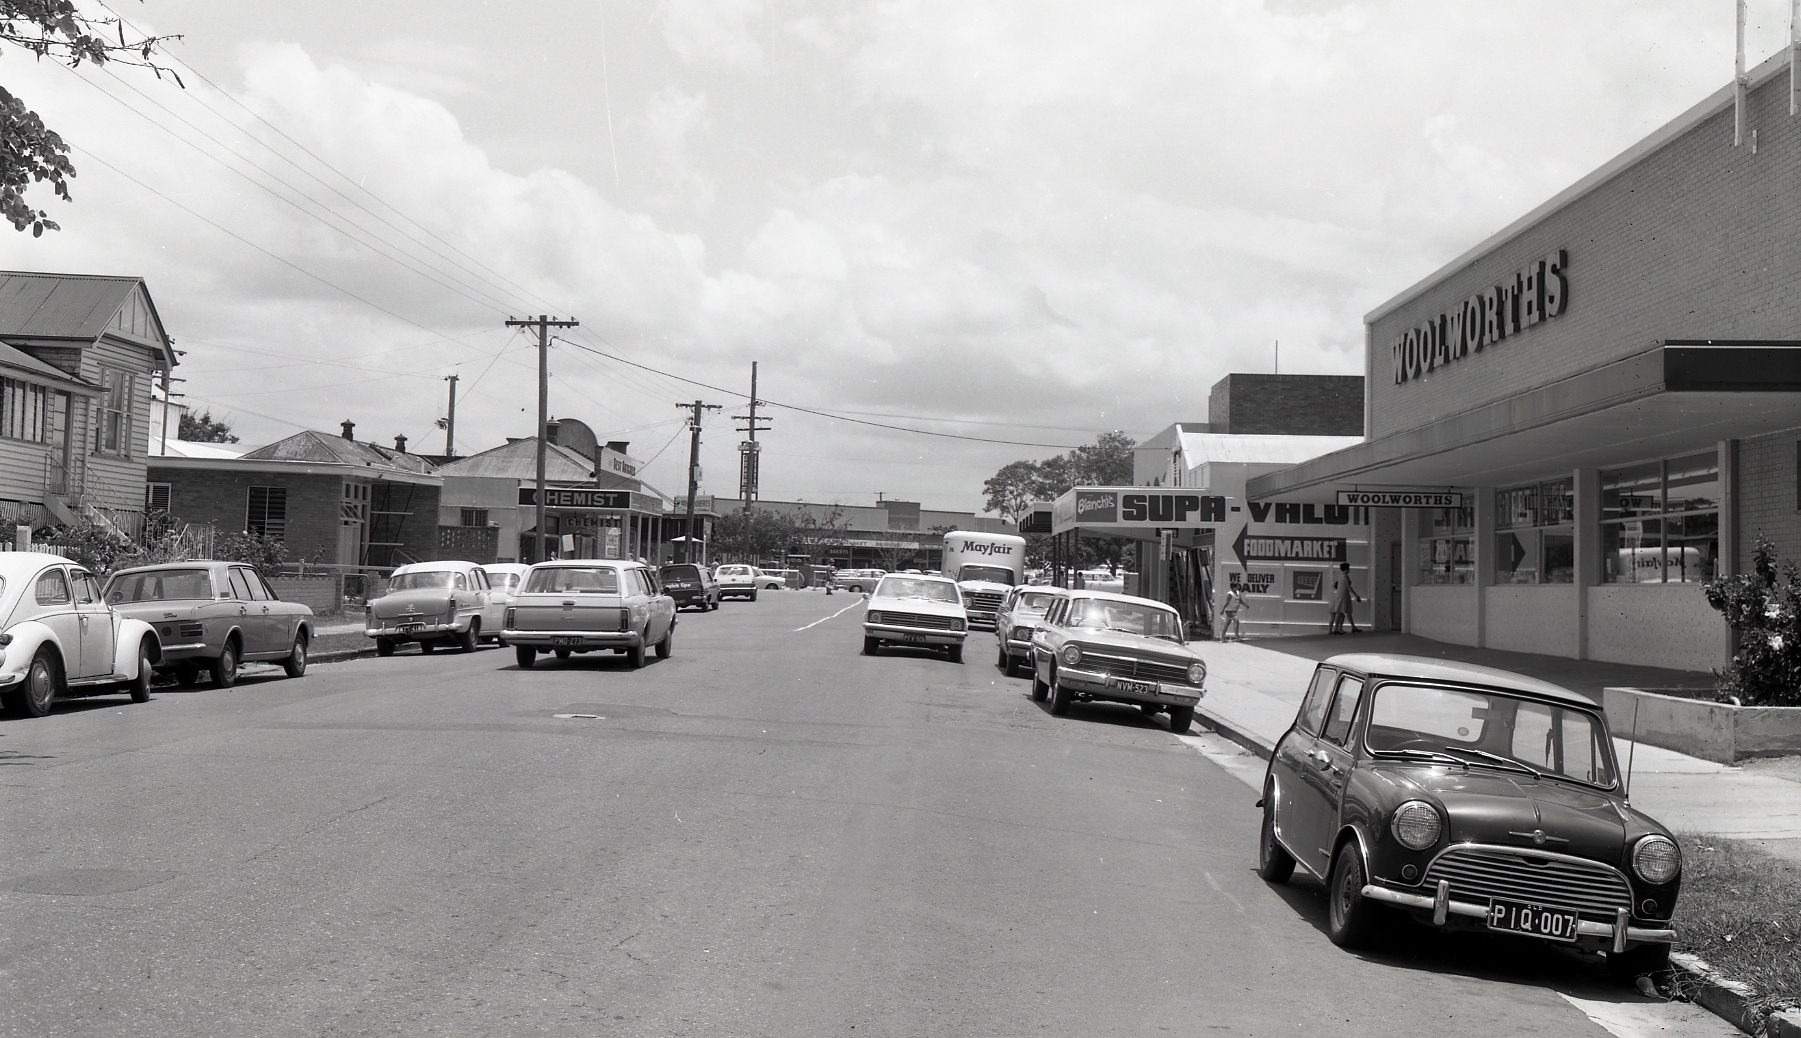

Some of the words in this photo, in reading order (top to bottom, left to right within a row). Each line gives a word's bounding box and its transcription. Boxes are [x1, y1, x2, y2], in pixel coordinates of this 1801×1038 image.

[1392, 249, 1568, 385] WOOLWORTHS
[1077, 494, 1116, 516] Bianchi's
[1346, 493, 1454, 506] WOOLWORTHS
[567, 517, 621, 528] CHEMIST
[960, 540, 1013, 556] Mayfair
[1243, 538, 1338, 559] FOODMARKET
[1229, 572, 1242, 583] WE
[1247, 573, 1276, 584] DELIVER
